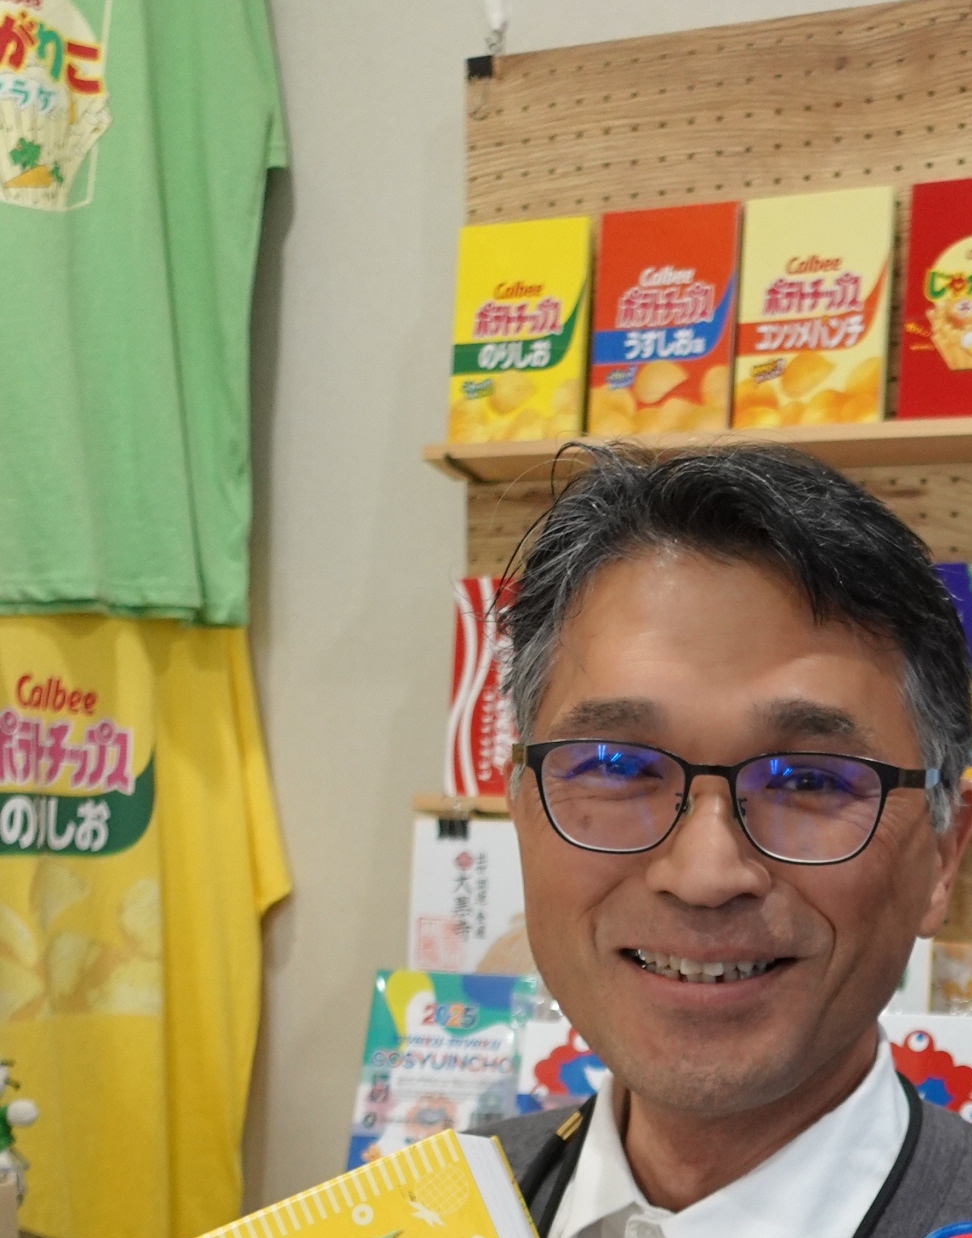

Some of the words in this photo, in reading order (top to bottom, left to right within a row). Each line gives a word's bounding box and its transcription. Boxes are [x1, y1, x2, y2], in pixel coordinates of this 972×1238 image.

[615, 282, 714, 328] ポテトチップス
[762, 272, 864, 317] ポテトチップス
[473, 297, 563, 338] ポテトチップス
[755, 314, 866, 351] コンソメパンチ
[477, 340, 551, 370] のりしお
[16, 674, 98, 716] Calbee
[421, 1003, 479, 1028] 2025
